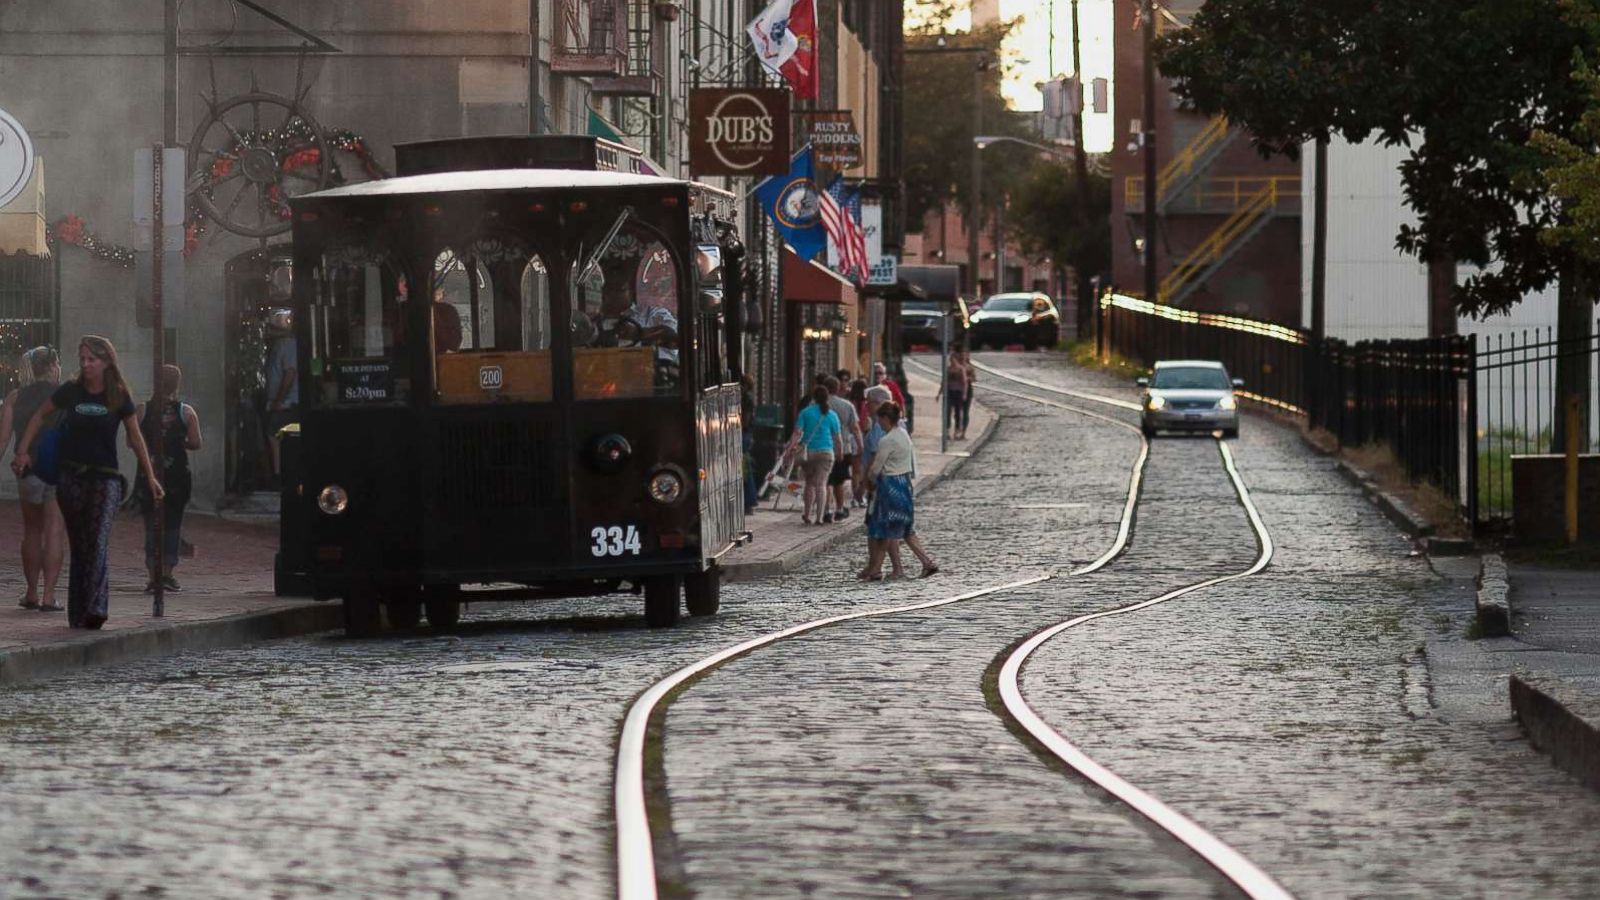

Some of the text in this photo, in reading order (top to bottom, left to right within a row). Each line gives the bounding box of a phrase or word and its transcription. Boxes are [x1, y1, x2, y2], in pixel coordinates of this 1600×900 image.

[705, 116, 773, 143] DUB'S
[815, 122, 849, 132] RUSTY
[482, 370, 500, 384] 200
[345, 387, 386, 400] 8:20pm
[591, 525, 641, 557] 334
